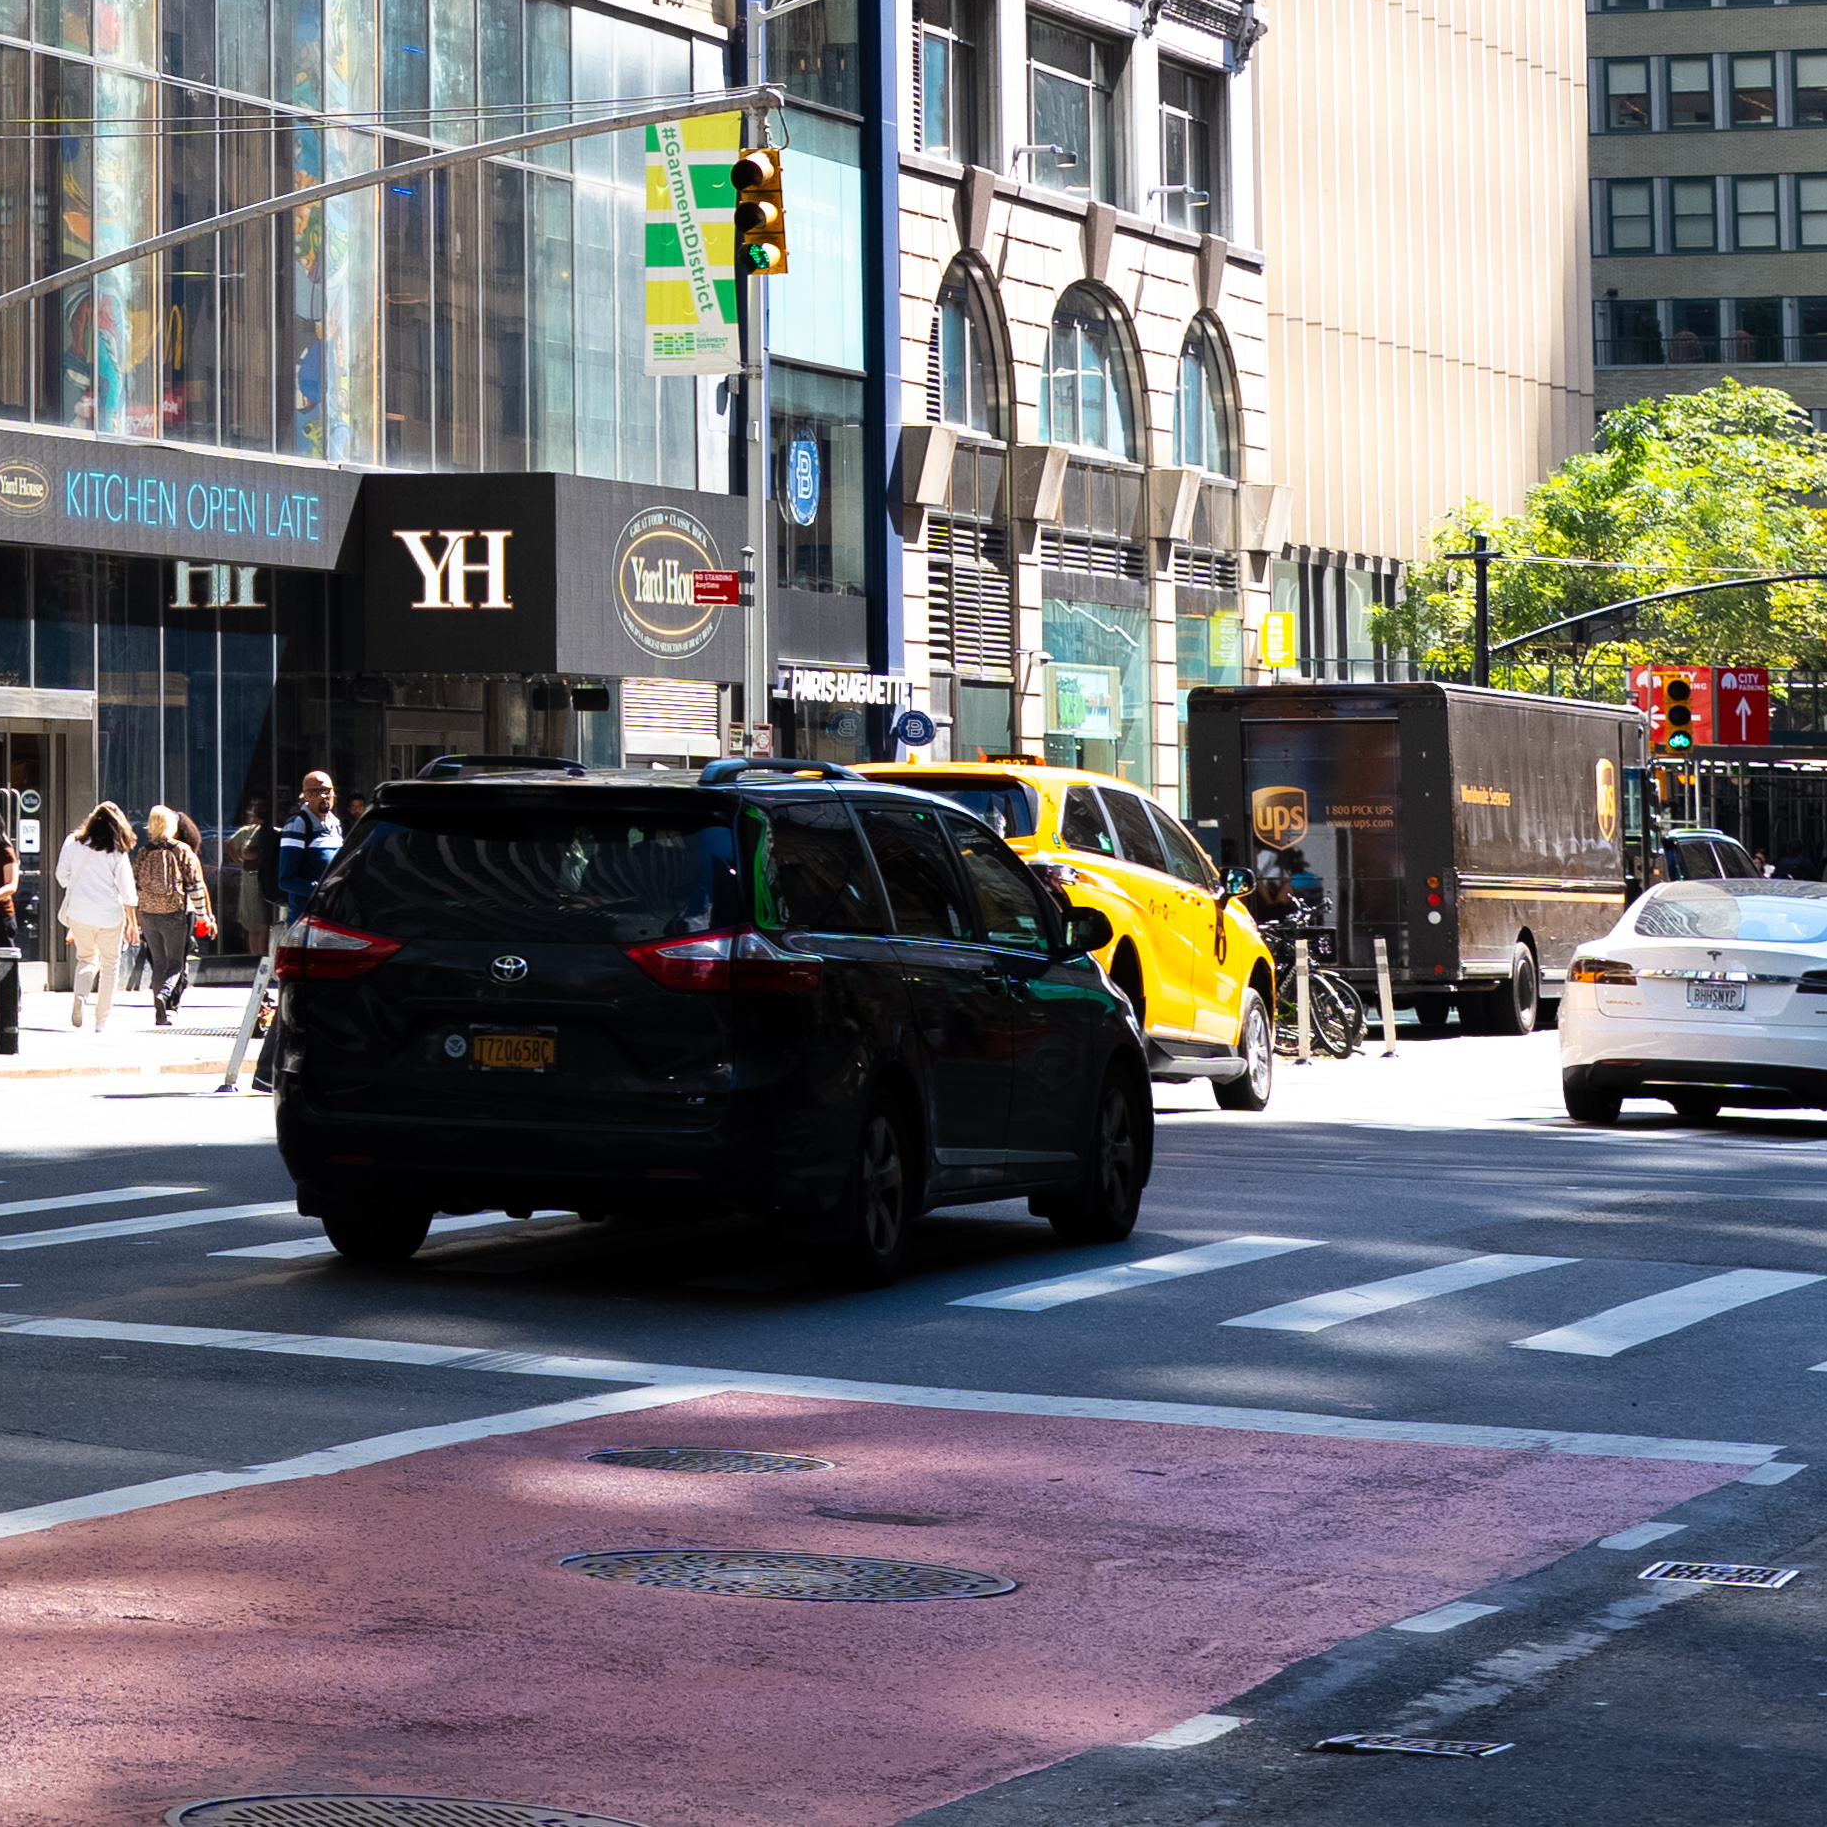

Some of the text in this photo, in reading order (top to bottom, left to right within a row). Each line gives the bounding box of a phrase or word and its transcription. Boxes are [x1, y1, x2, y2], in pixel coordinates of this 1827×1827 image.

[659, 126, 716, 314] #GarmentDistrict
[18, 477, 44, 500] House
[66, 470, 320, 543] KITCHEN OPEN LATE
[392, 529, 514, 610] YH
[630, 555, 695, 606] Yard Hou
[704, 574, 733, 582] STANDING
[1738, 673, 1759, 683] CITY
[1738, 683, 1766, 692] PARKING
[1460, 783, 1512, 807] Worldwide Services
[1598, 784, 1615, 829] ups
[1325, 804, 1394, 816] 1 800 PICK UPS
[1256, 805, 1304, 841] ups
[1324, 818, 1394, 831] www.ups.com
[1694, 989, 1737, 1004] BHHSNYP
[477, 1037, 550, 1063] T720658C
